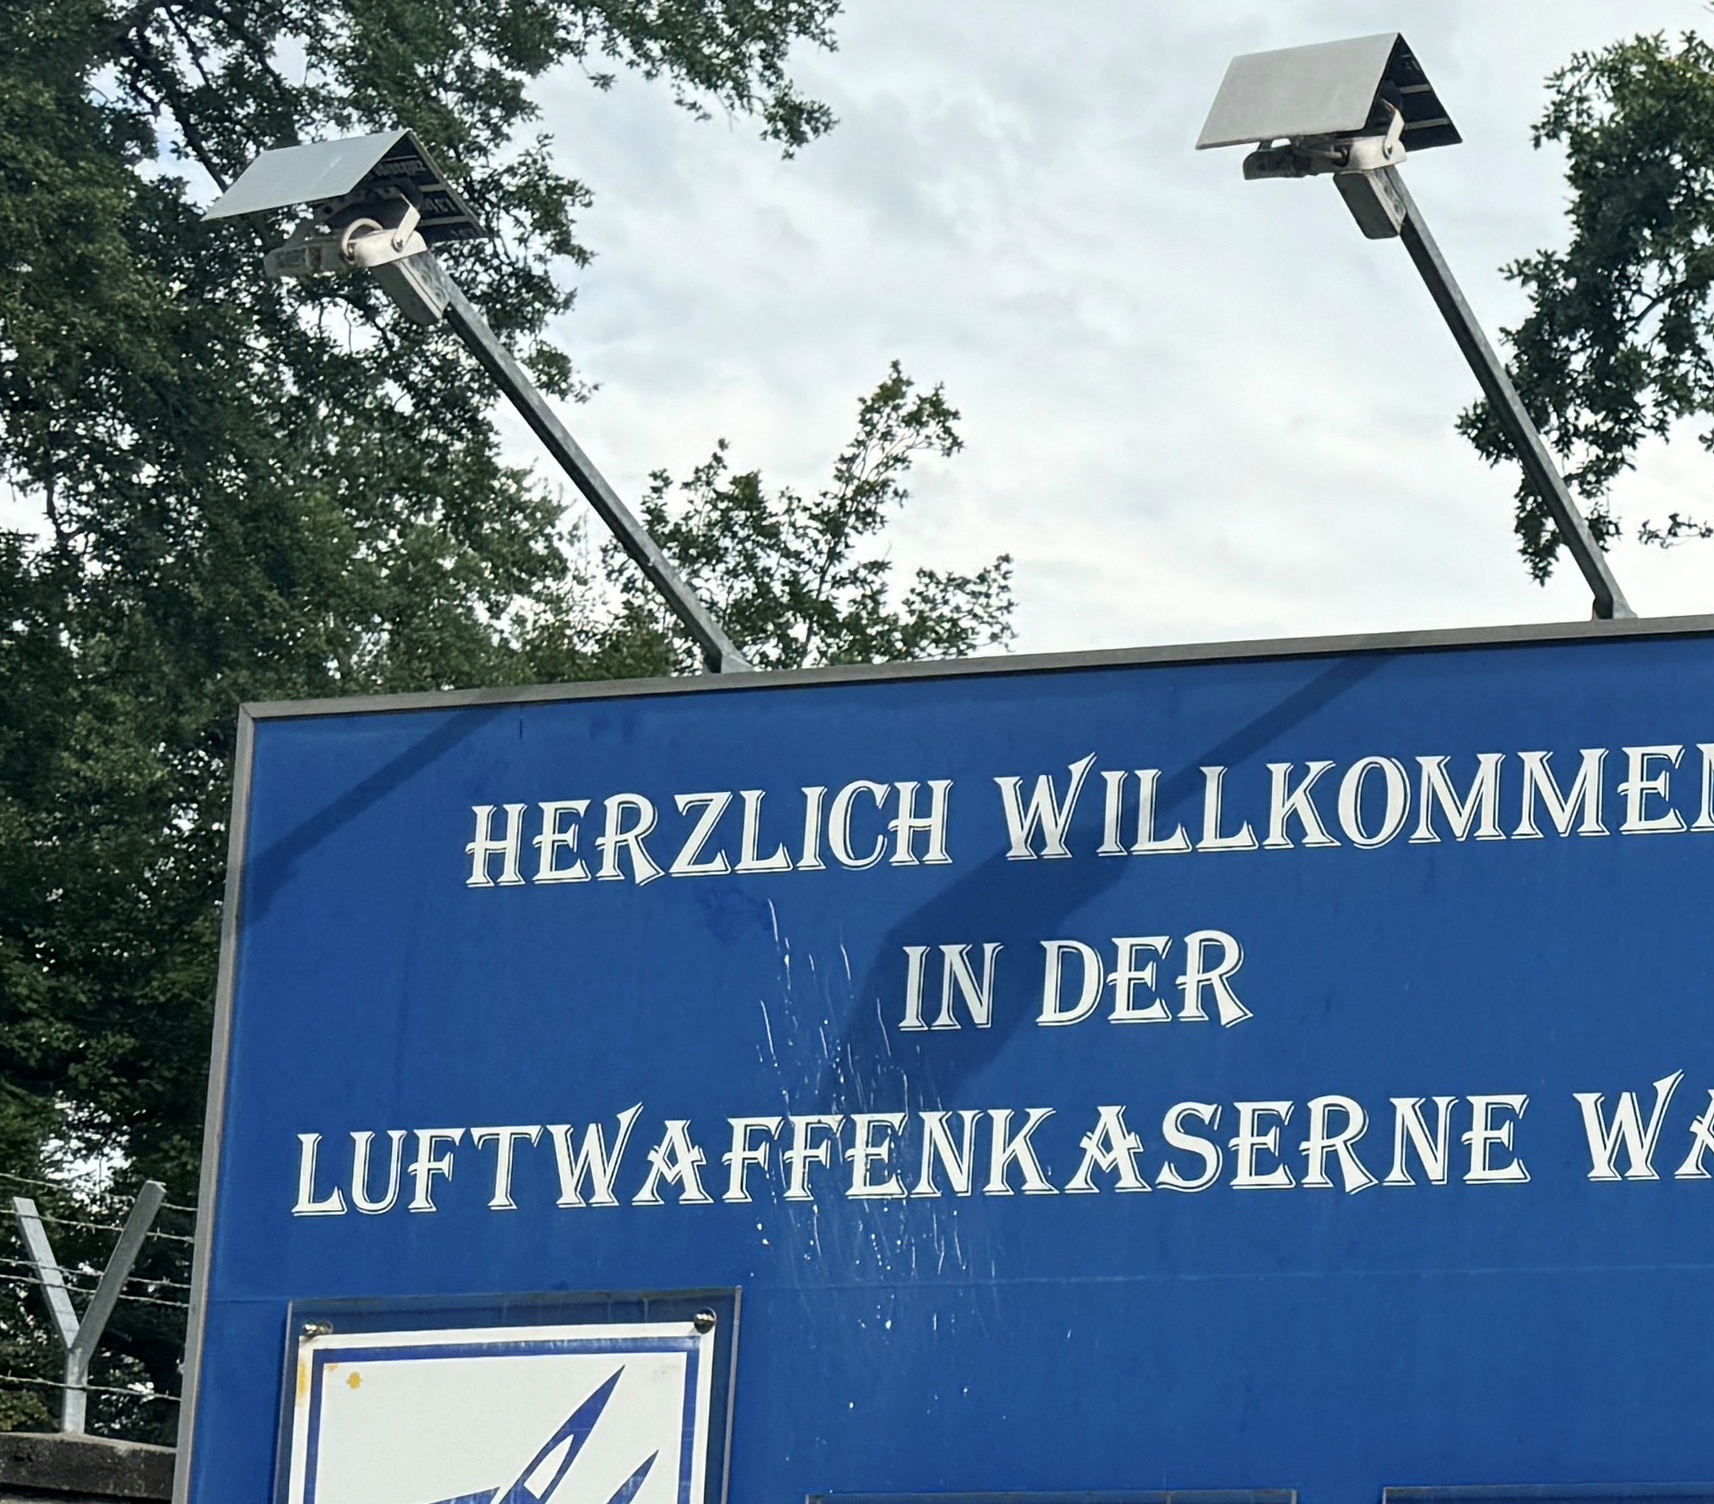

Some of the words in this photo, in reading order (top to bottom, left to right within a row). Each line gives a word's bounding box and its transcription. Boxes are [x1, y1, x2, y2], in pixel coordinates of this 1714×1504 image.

[465, 779, 954, 888] HERZLICH
[898, 943, 1003, 1031] IN
[1036, 930, 1254, 1029] DER
[291, 1096, 1530, 1214] LUFTWAFFENKASERNE
